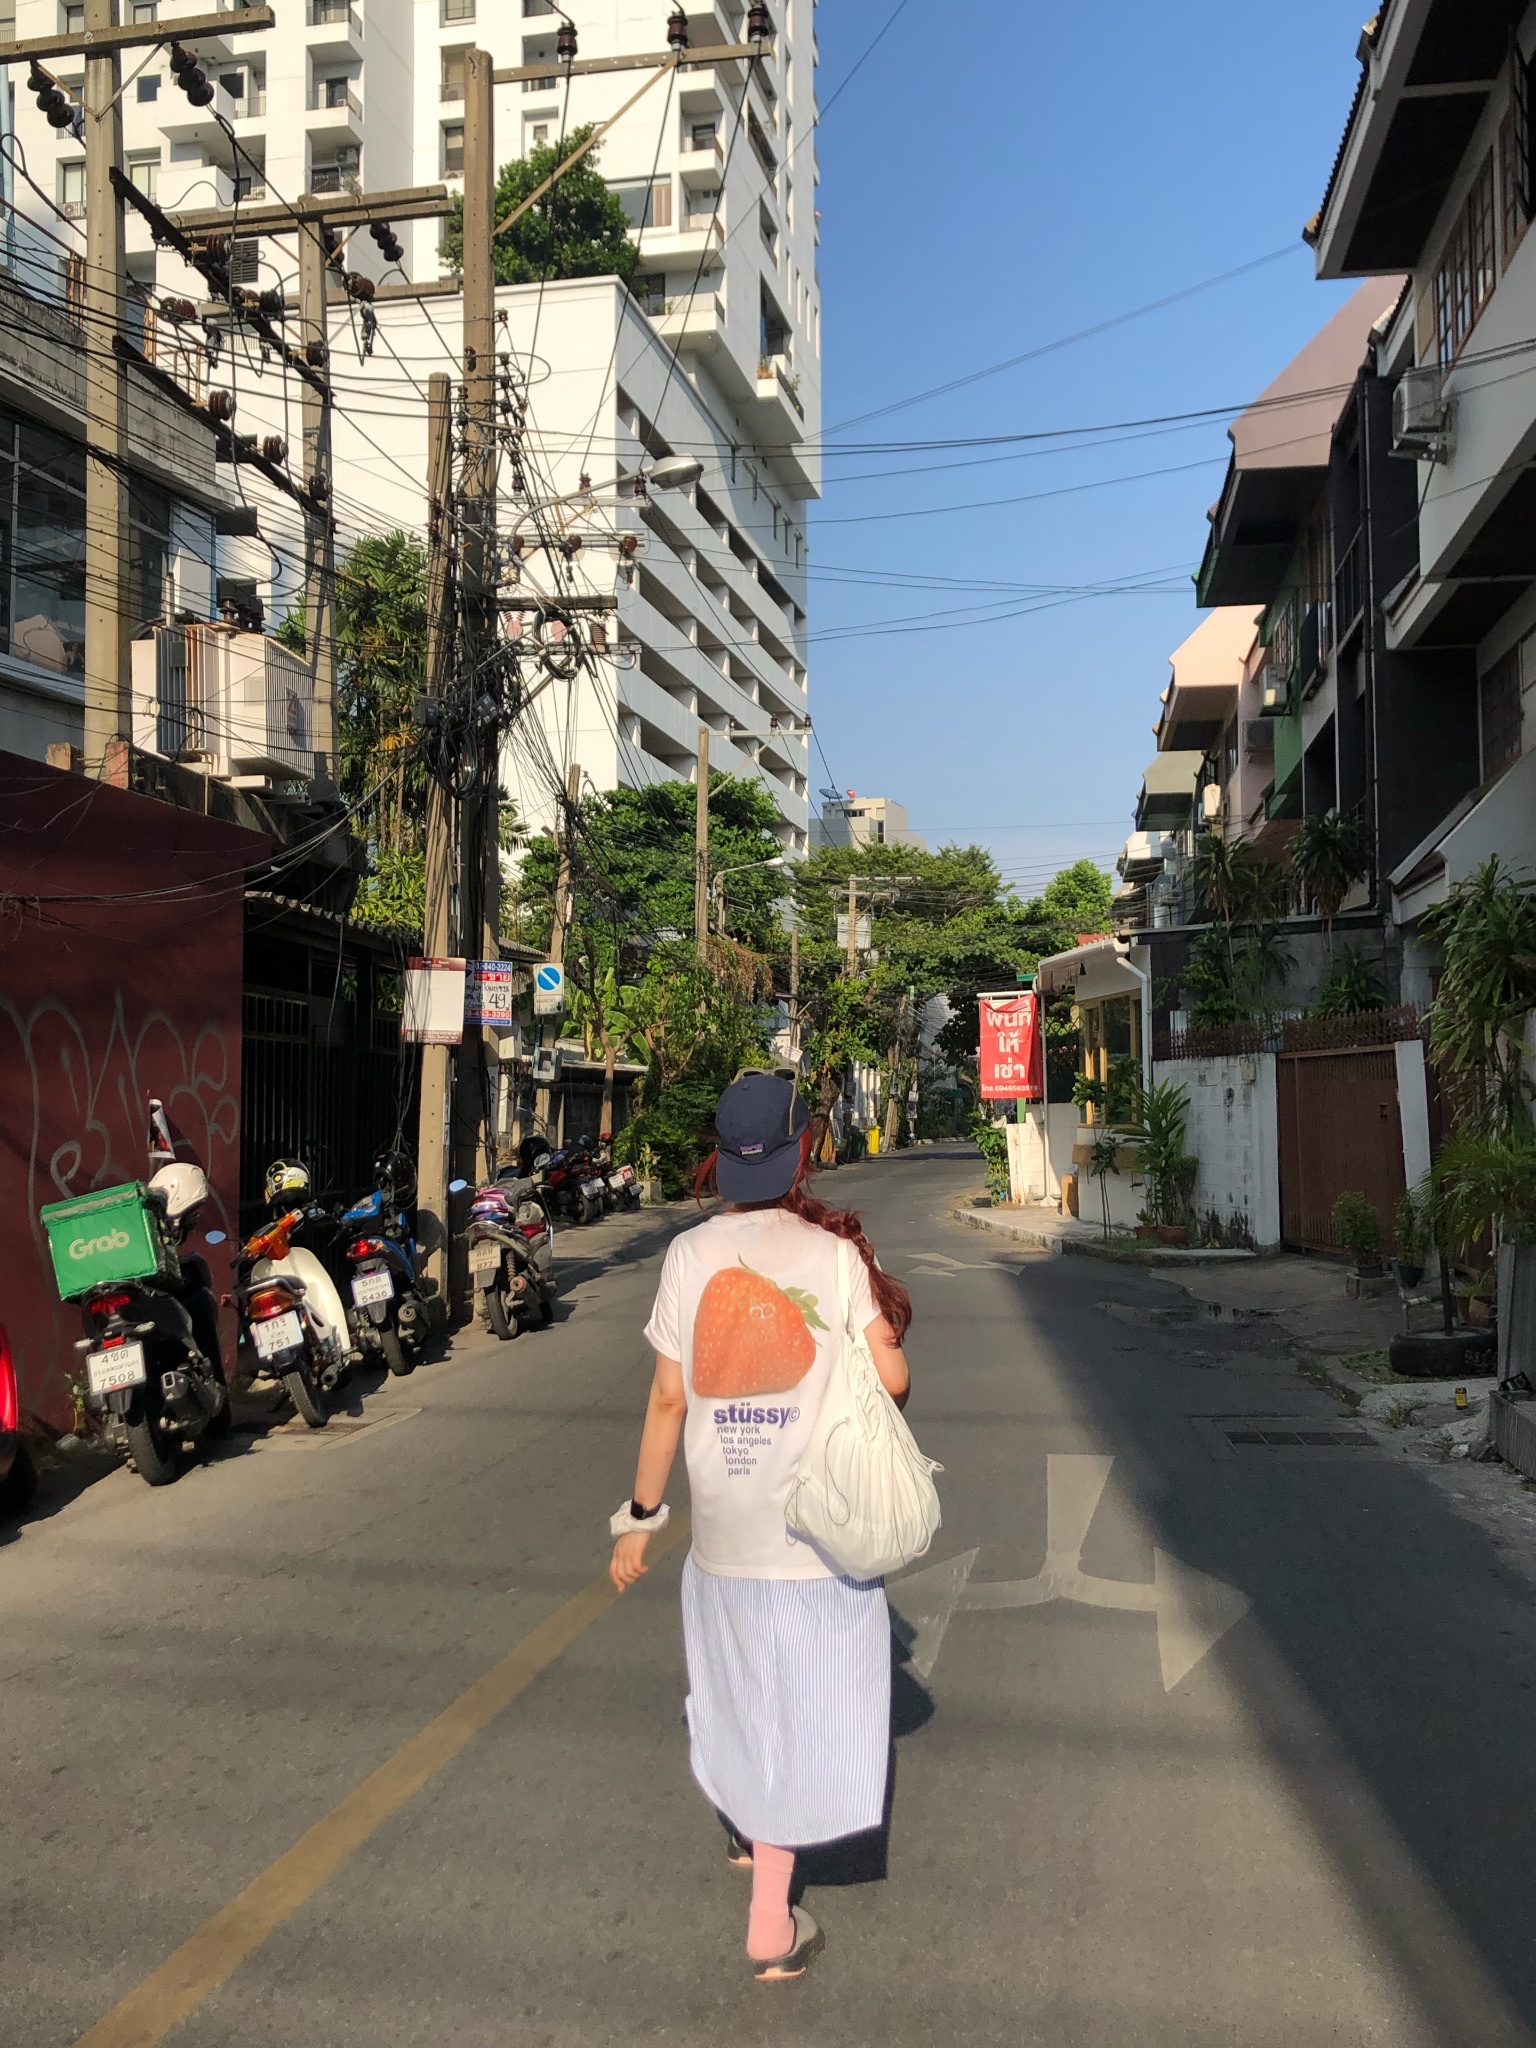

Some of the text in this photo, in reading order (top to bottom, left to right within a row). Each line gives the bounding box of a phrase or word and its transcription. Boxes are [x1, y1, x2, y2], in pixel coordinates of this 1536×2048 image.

[994, 1057, 1025, 1079] เช่า
[69, 1228, 130, 1260] Grab
[362, 1289, 388, 1303] 5436
[268, 1335, 291, 1351] 751
[99, 1370, 136, 1389] 7508
[717, 1424, 761, 1436] new york
[720, 1434, 772, 1447] los angeles
[722, 1445, 750, 1457] tokyo
[725, 1456, 758, 1465] london
[727, 1465, 751, 1477] paris
